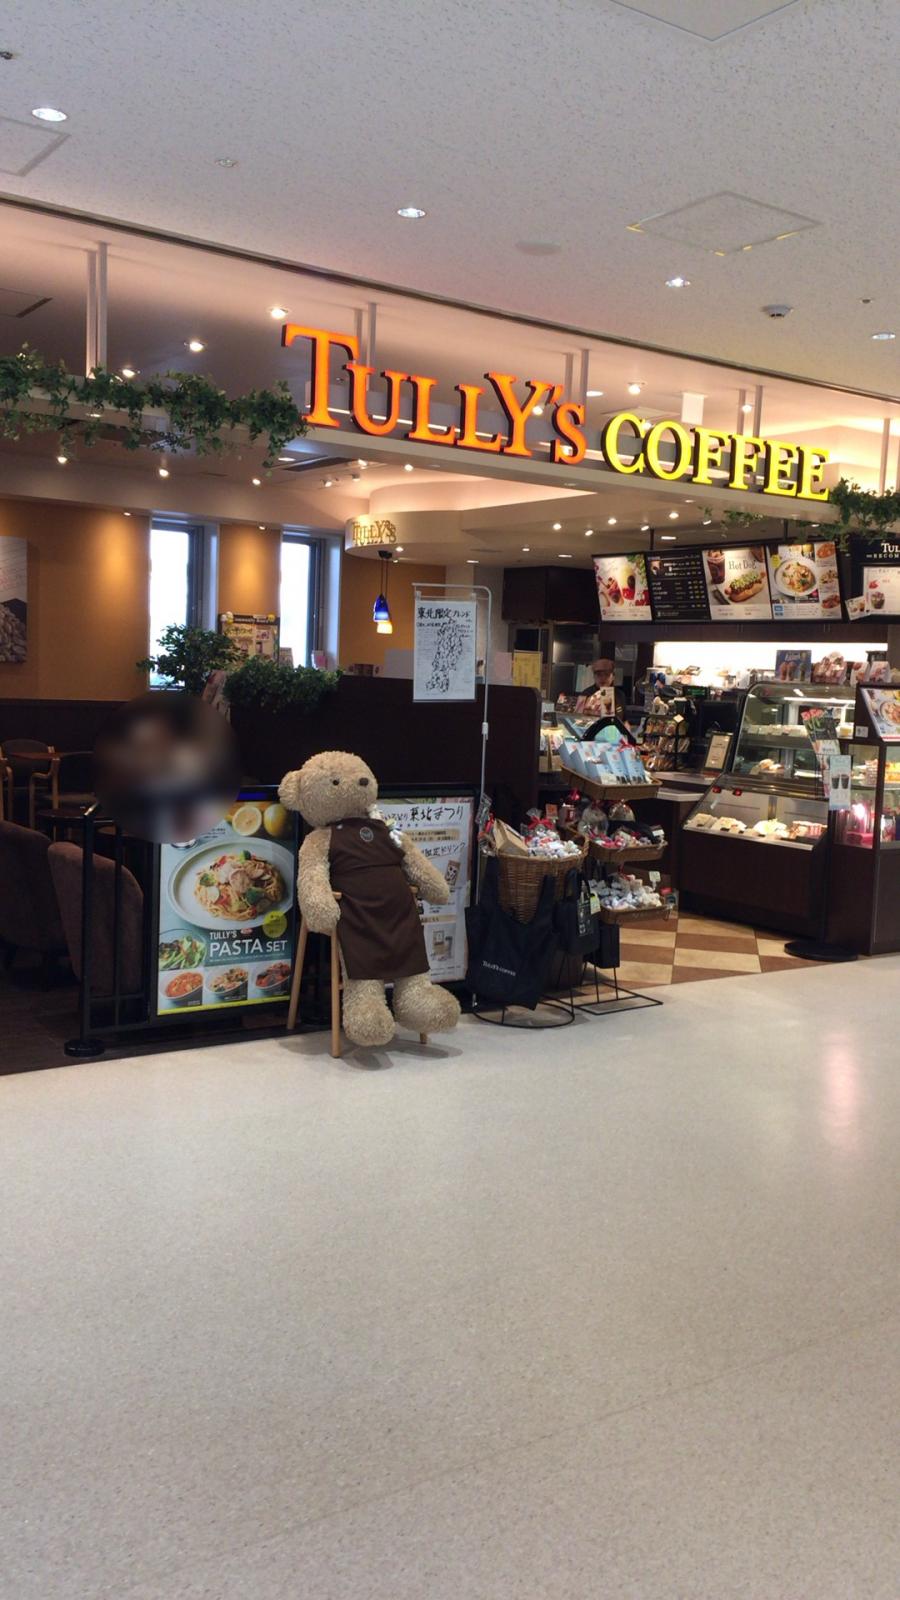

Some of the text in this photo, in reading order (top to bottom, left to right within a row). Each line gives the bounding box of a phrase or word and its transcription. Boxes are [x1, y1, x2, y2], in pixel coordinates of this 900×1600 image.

[601, 412, 830, 501] COFFEE
[728, 559, 757, 570] Hot Dog
[209, 930, 238, 940] TULLY'S
[209, 938, 263, 958] PASTA
[266, 940, 288, 952] SET
